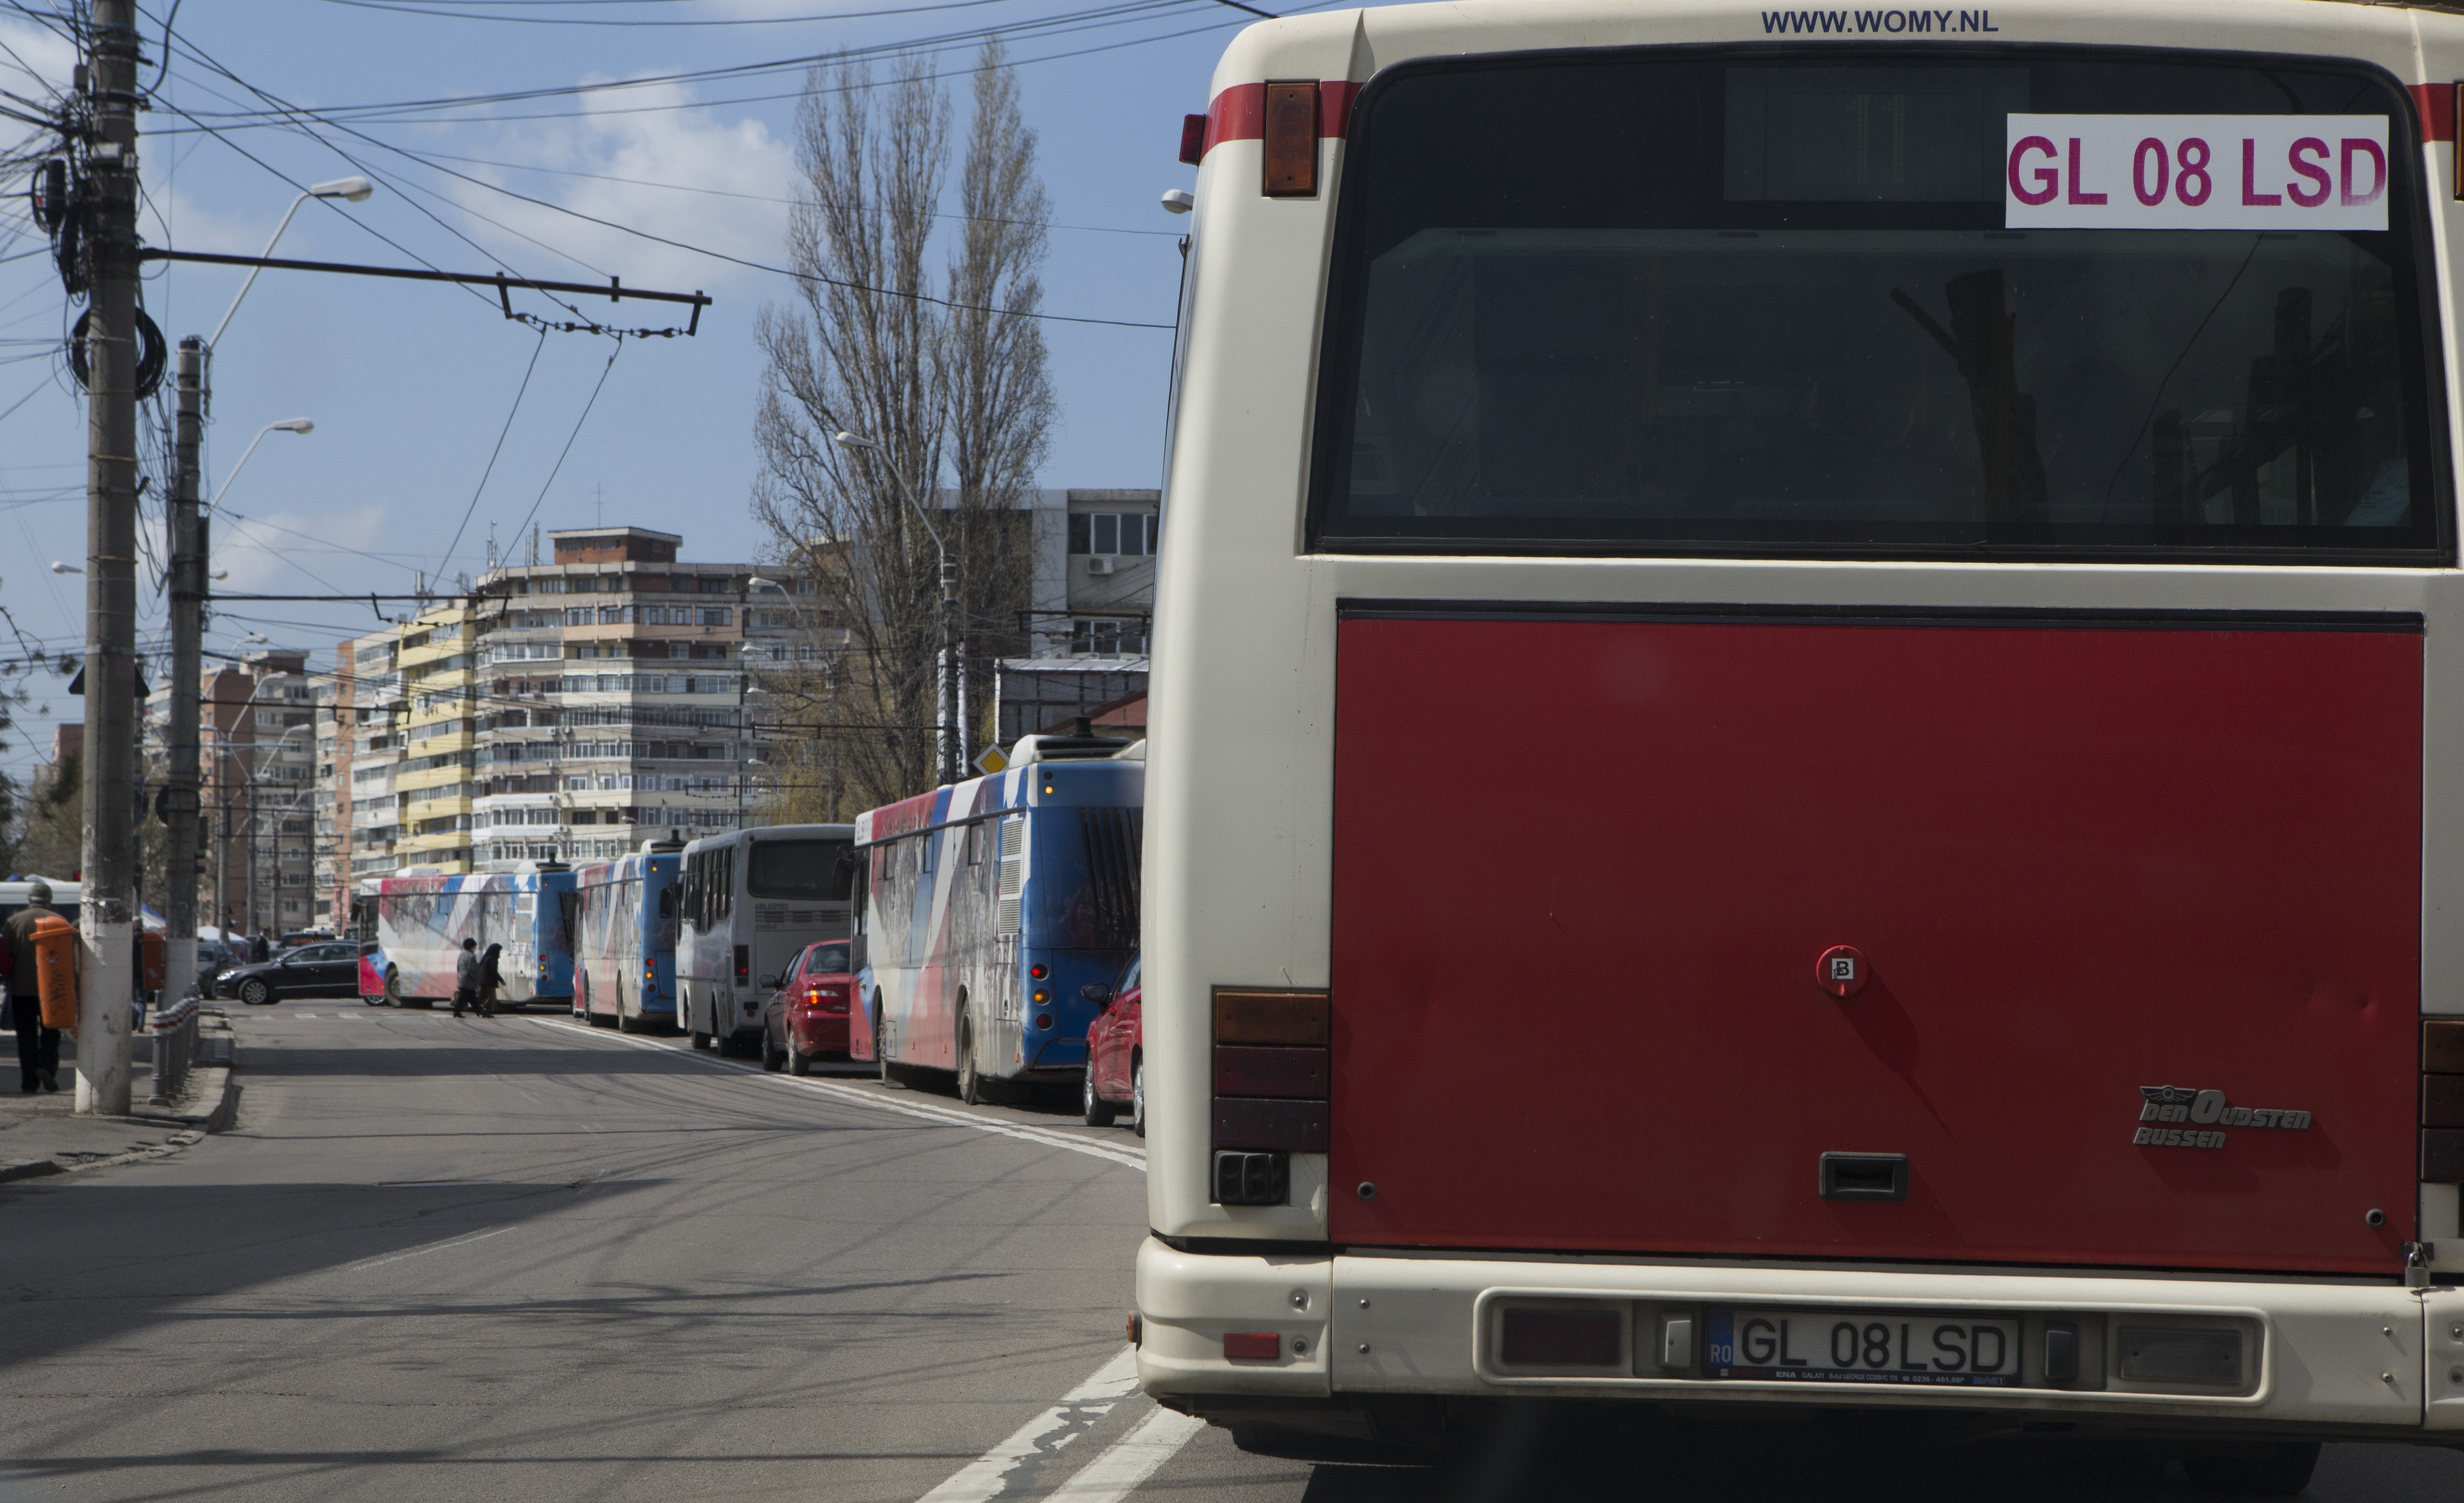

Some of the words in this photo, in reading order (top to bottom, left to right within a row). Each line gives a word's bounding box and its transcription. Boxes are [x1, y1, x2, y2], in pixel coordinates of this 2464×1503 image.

[1761, 10, 1999, 33] WWW.WOMY.NL
[2007, 136, 2107, 206] GL
[2133, 137, 2212, 206] 08
[2242, 137, 2386, 207] LSD
[1836, 961, 1850, 976] B
[2139, 1099, 2189, 1122] DEN
[2132, 1127, 2226, 1149] BUSSEN
[1710, 1344, 1731, 1364] RO
[1741, 1318, 1807, 1367] GL
